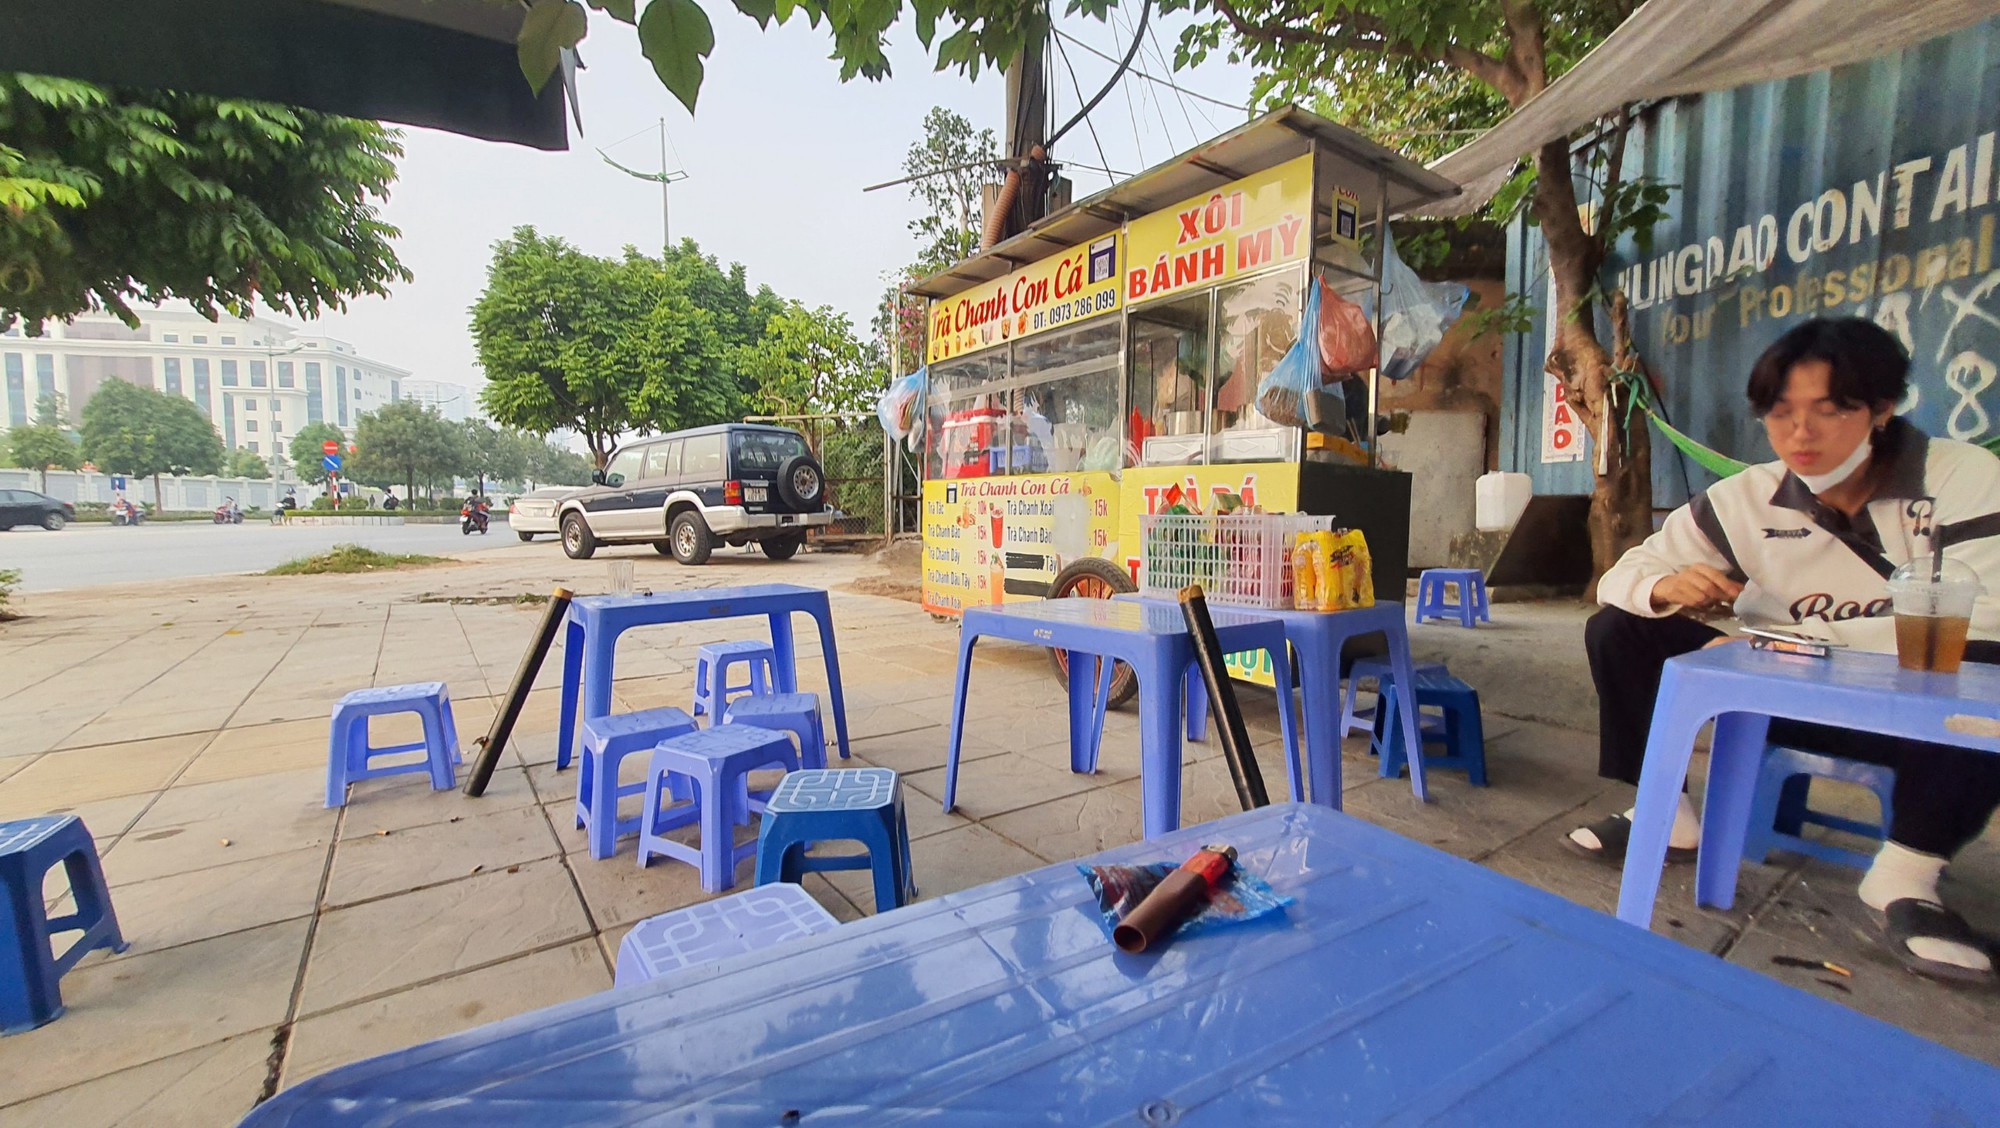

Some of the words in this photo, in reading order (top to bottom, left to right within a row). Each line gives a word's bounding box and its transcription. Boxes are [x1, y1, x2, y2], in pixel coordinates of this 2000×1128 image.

[1786, 131, 2000, 264] CONTAI
[1178, 193, 1242, 244] XÔI
[1128, 244, 1225, 300] BÁNH
[1237, 214, 1302, 270] MỲ
[1738, 213, 1996, 329] Professional
[932, 306, 951, 342] Trà
[955, 287, 1008, 333] Chanh
[1012, 275, 1049, 314] Con
[1054, 253, 1084, 300] Cá
[1050, 302, 1072, 325] 0973
[1074, 295, 1093, 317] 286
[1095, 288, 1116, 309] 099
[960, 482, 976, 497] Trà
[979, 481, 1017, 496] Chanh
[1021, 479, 1047, 495] Con
[1050, 478, 1069, 494] Cá
[927, 502, 935, 515] Trà
[1007, 499, 1017, 515] Trà
[1018, 499, 1038, 516] Chanh
[1094, 499, 1108, 517] 15k
[927, 524, 935, 538] Trà
[936, 523, 950, 539] Chanh
[977, 525, 988, 541] 15k
[1007, 526, 1017, 542] Trà
[1018, 526, 1038, 543] Chanh
[1093, 529, 1108, 547] 15k
[927, 546, 936, 560] Trà
[936, 546, 950, 561] Chanh
[977, 550, 988, 565] 15k
[935, 569, 950, 584] Chanh
[977, 574, 988, 590] 15k
[935, 592, 950, 608] Chanh
